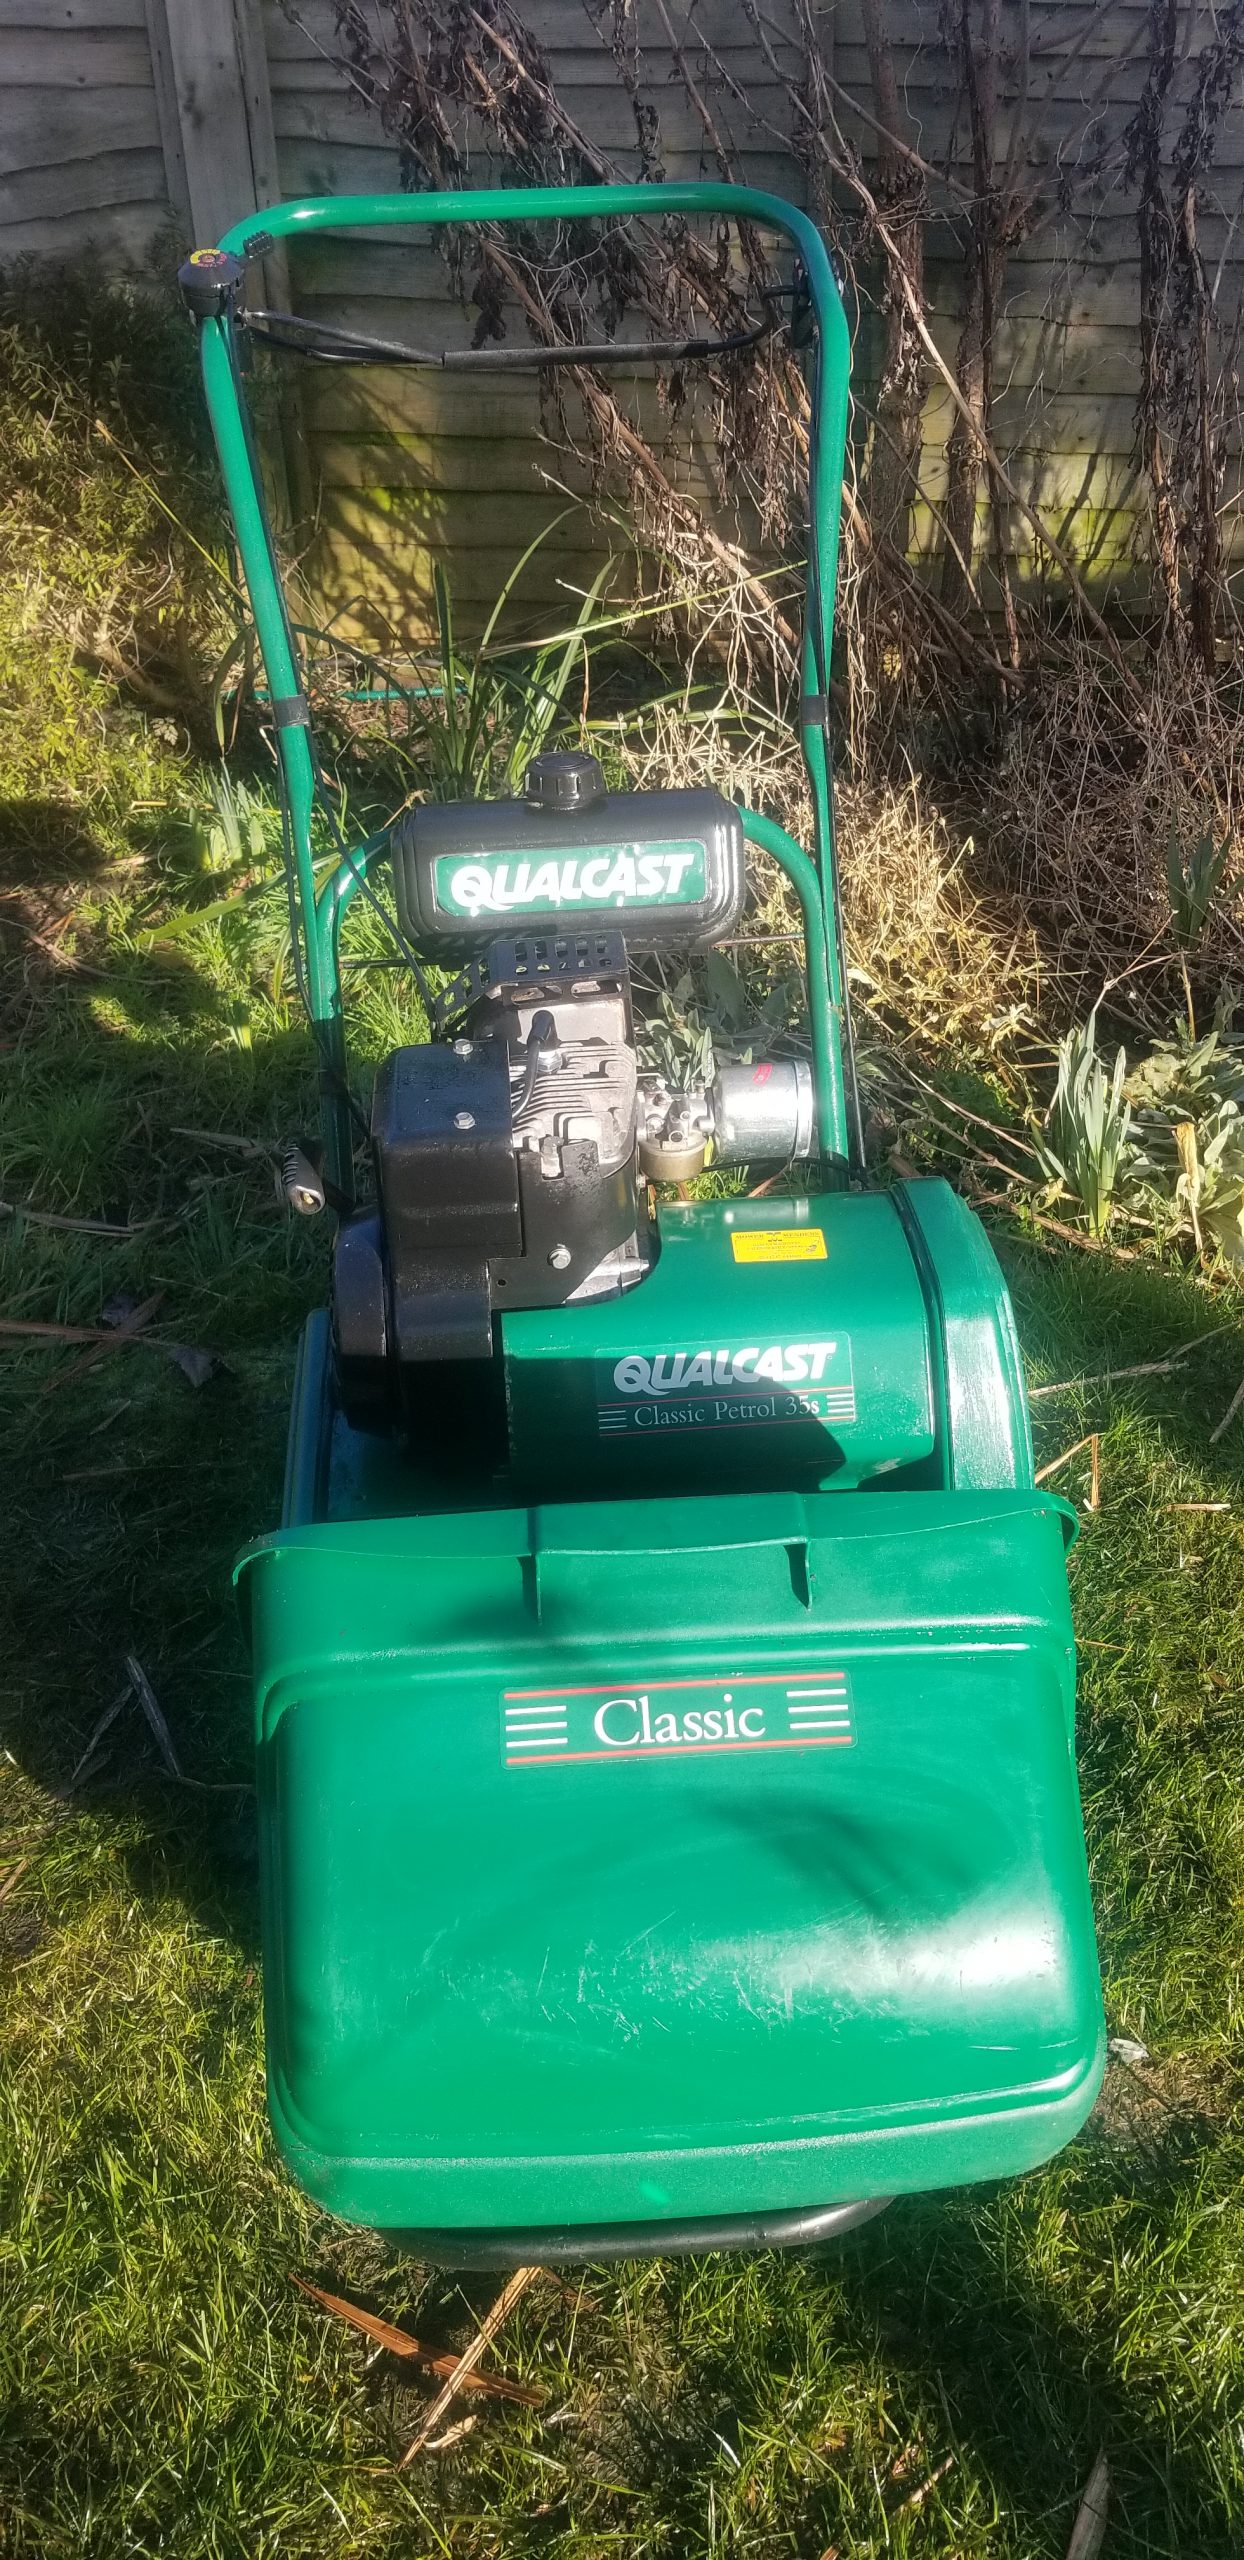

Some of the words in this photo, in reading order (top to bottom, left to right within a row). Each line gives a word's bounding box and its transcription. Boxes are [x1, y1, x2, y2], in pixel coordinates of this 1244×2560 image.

[451, 854, 694, 911] QUALCAST
[613, 1342, 837, 1396] QUALCAST
[634, 1403, 705, 1426] Classic
[714, 1398, 777, 1420] Petrol
[785, 1396, 820, 1415] 35s
[594, 1693, 766, 1746] Classic
